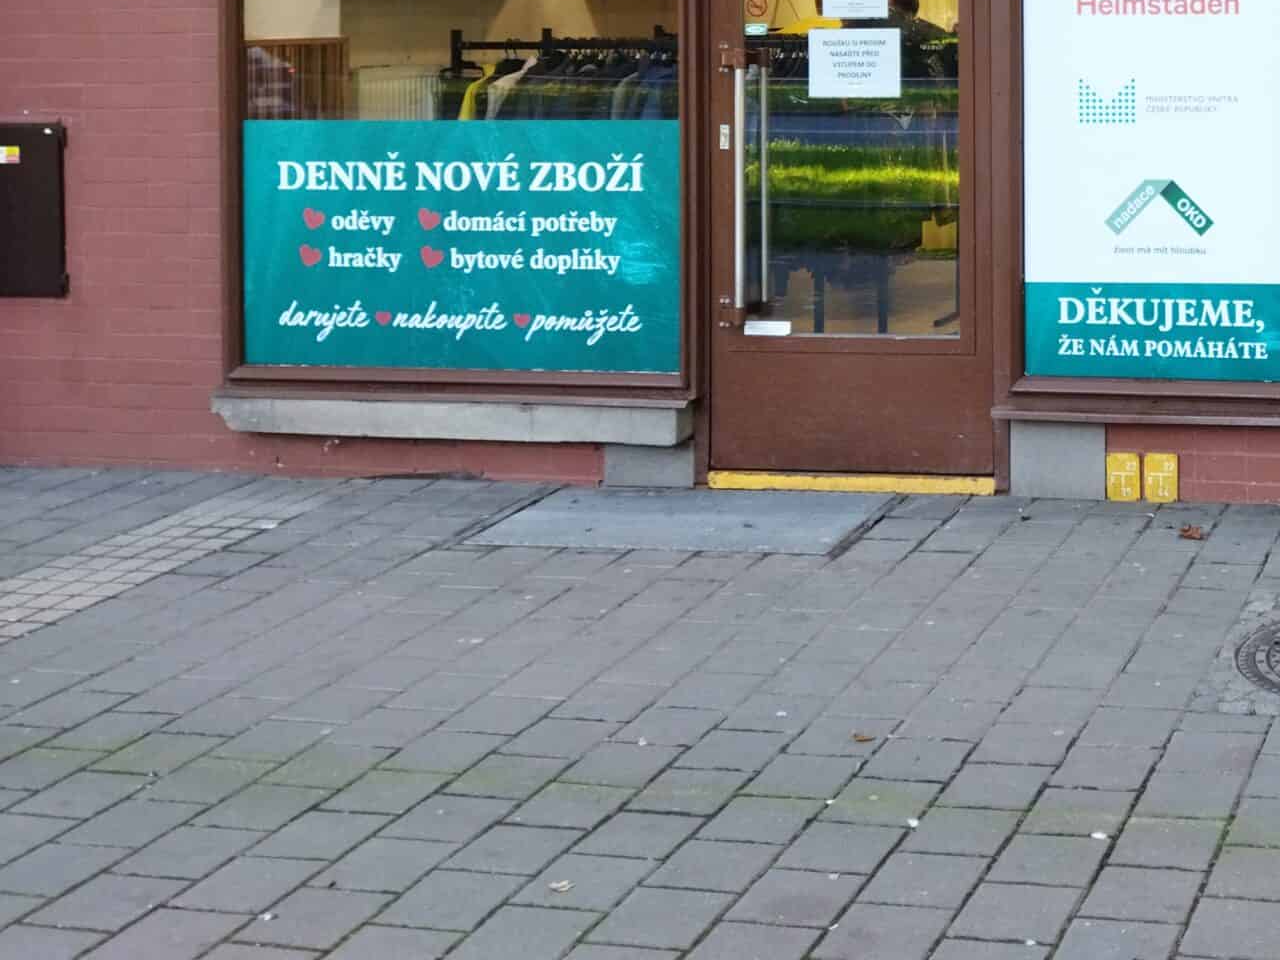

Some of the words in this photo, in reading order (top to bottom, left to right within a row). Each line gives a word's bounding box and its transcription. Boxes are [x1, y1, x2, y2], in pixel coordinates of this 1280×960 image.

[277, 151, 408, 192] DENNĚ
[415, 152, 522, 193] NOVÉ
[528, 152, 645, 193] ZBOŽÍ
[331, 208, 395, 236] oděvy
[1113, 185, 1155, 229] nadace
[1176, 198, 1207, 229] OKD
[443, 209, 527, 233] domácí
[531, 210, 618, 238] potřeby
[328, 246, 402, 274] hračky
[450, 247, 525, 274] bytové
[530, 247, 621, 276] doplňky
[278, 300, 370, 343] darujete
[525, 303, 643, 346] pomůžete
[1057, 287, 1266, 333] DĚKUJEME,
[1057, 334, 1085, 357] ŽE
[1089, 334, 1140, 357] NÁM
[1144, 337, 1269, 360] POMÁHÁTE
